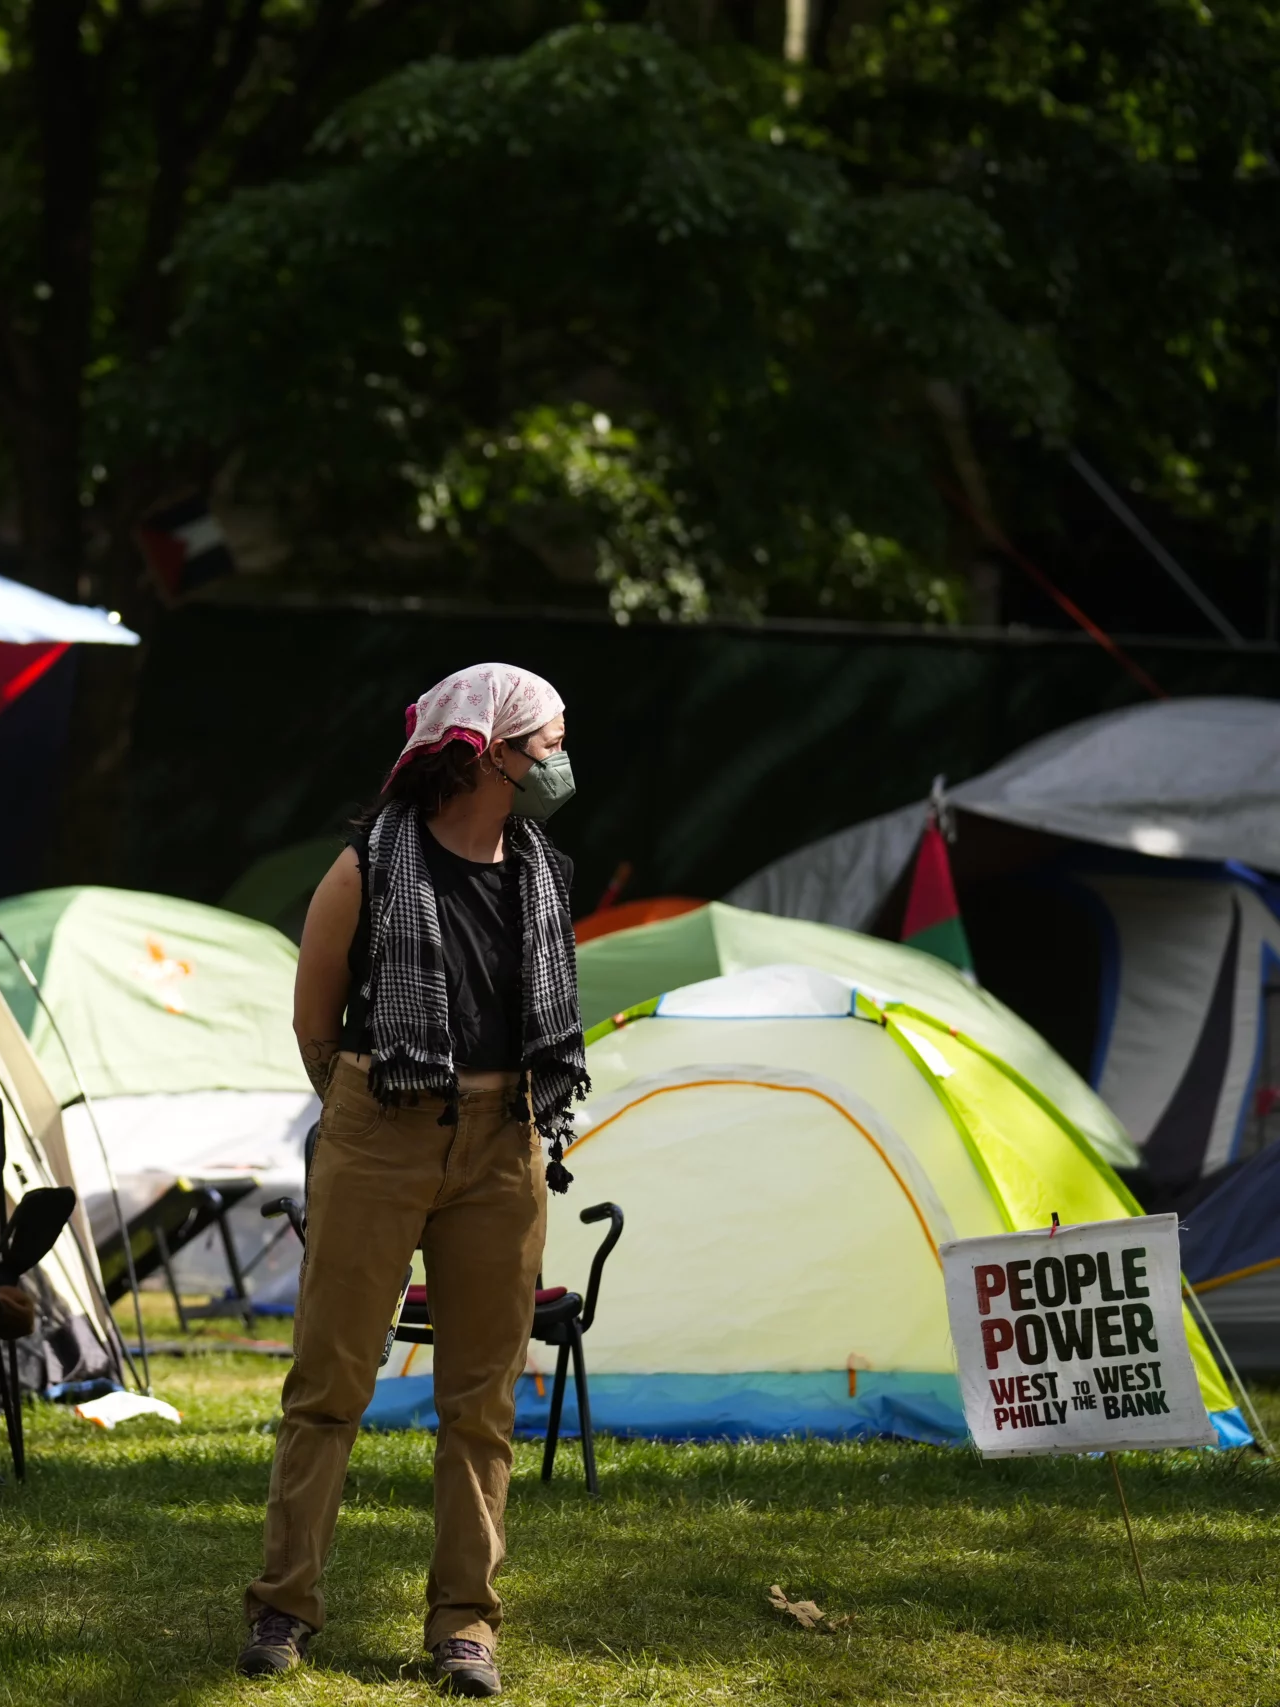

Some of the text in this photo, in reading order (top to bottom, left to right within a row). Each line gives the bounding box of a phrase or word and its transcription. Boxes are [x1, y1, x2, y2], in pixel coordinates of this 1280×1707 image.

[973, 1247, 1150, 1315] PEOPLE
[980, 1303, 1159, 1370] POWER
[989, 1361, 1162, 1406] WEST TO WEST
[993, 1390, 1171, 1431] PHILLY THE BANK
